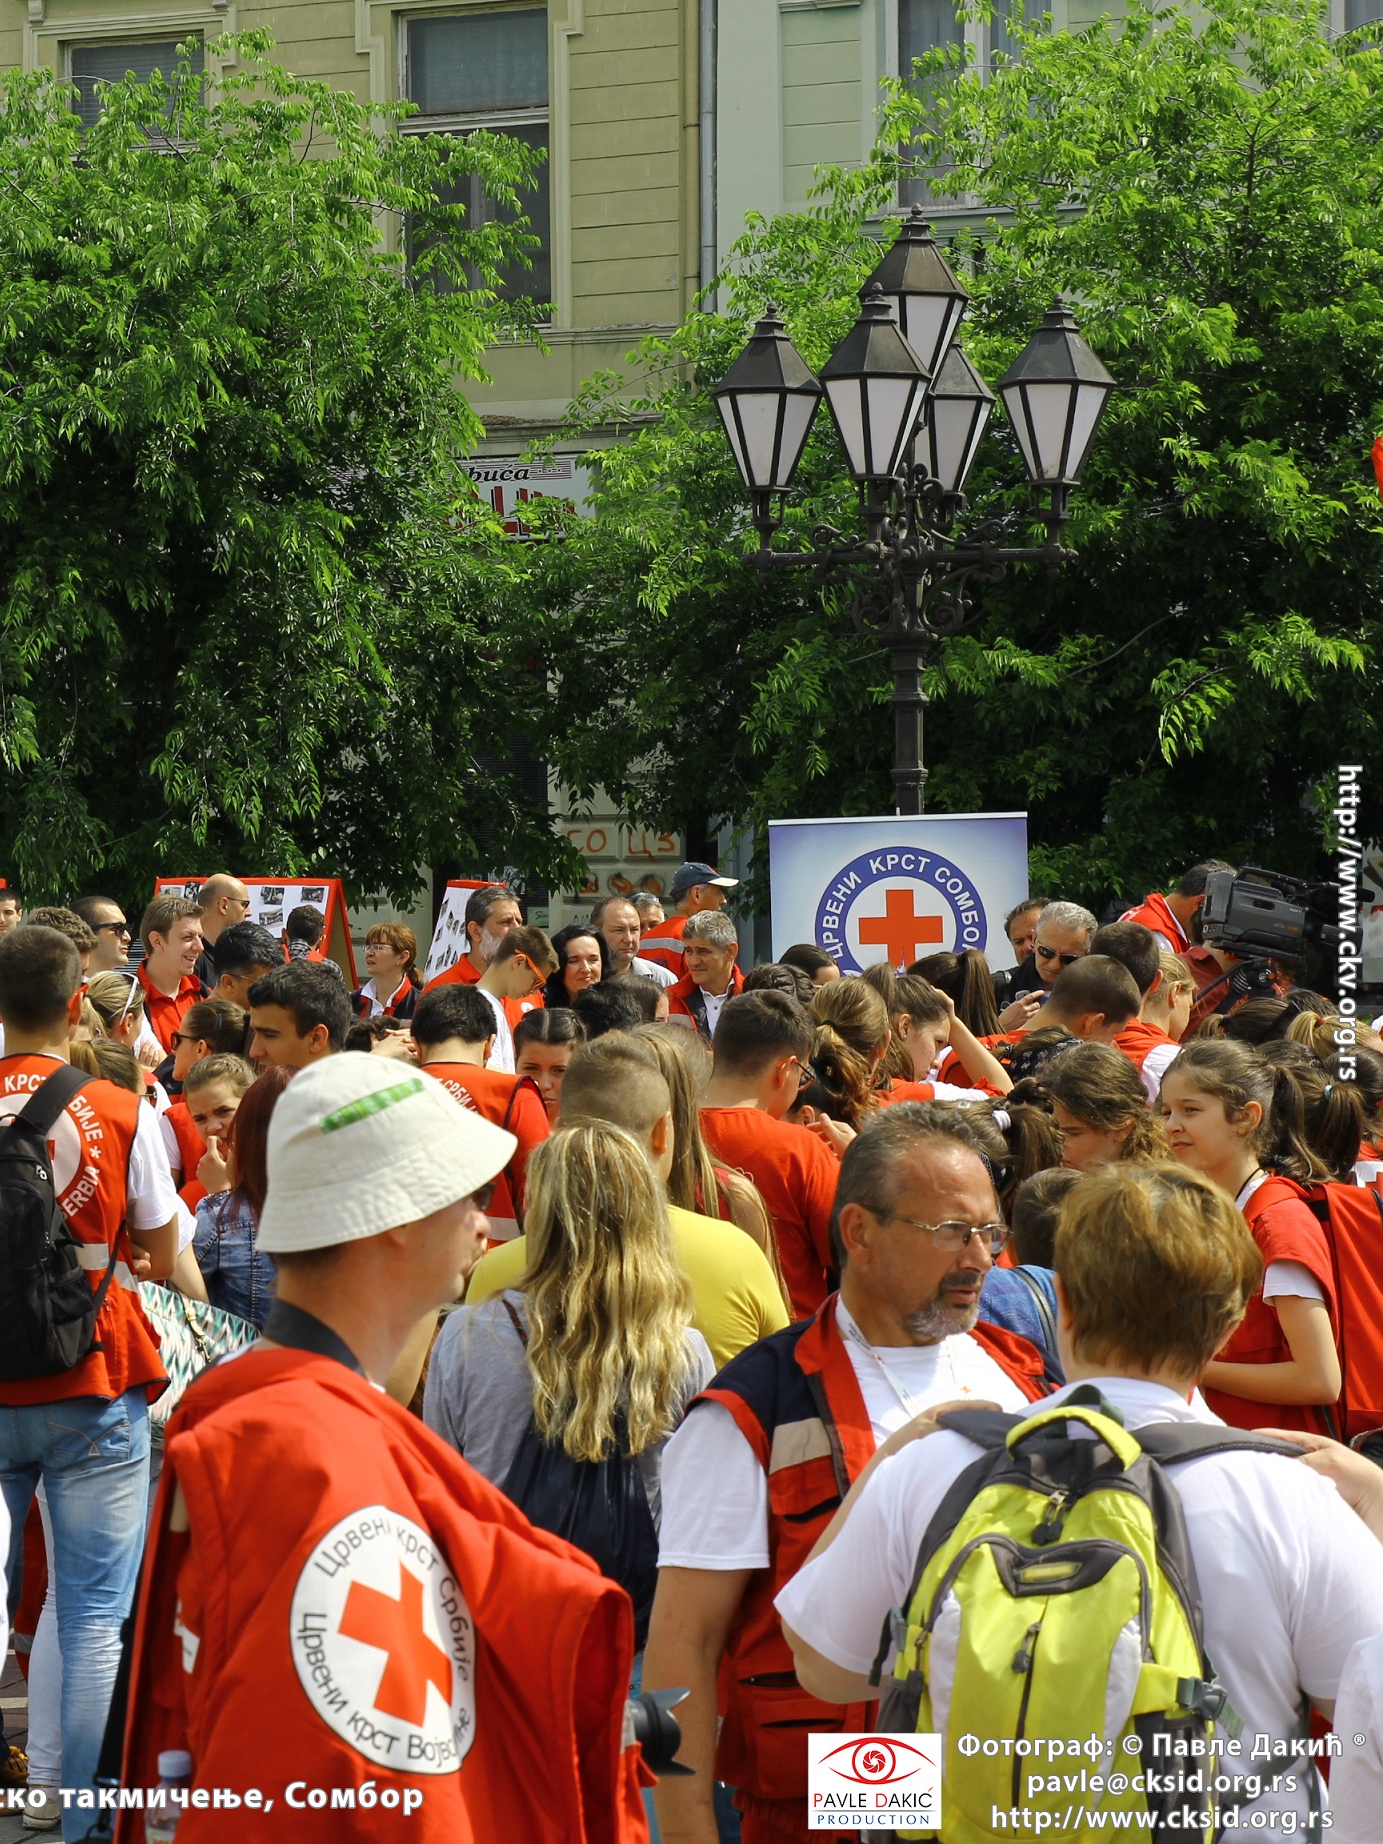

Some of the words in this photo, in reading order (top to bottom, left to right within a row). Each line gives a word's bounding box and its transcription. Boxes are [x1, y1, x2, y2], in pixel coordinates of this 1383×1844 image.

[467, 466, 531, 484] buća
[822, 871, 863, 959] ЦРВЕНИ
[869, 853, 931, 875] КРСТ
[934, 866, 980, 952] СОМБО
[5, 1073, 47, 1093] КРС
[68, 1094, 104, 1143] БИЈЕ
[61, 1165, 101, 1220] ERBIA
[396, 1525, 439, 1571] крст
[297, 1612, 349, 1714] Црвени
[346, 1710, 400, 1754] крст
